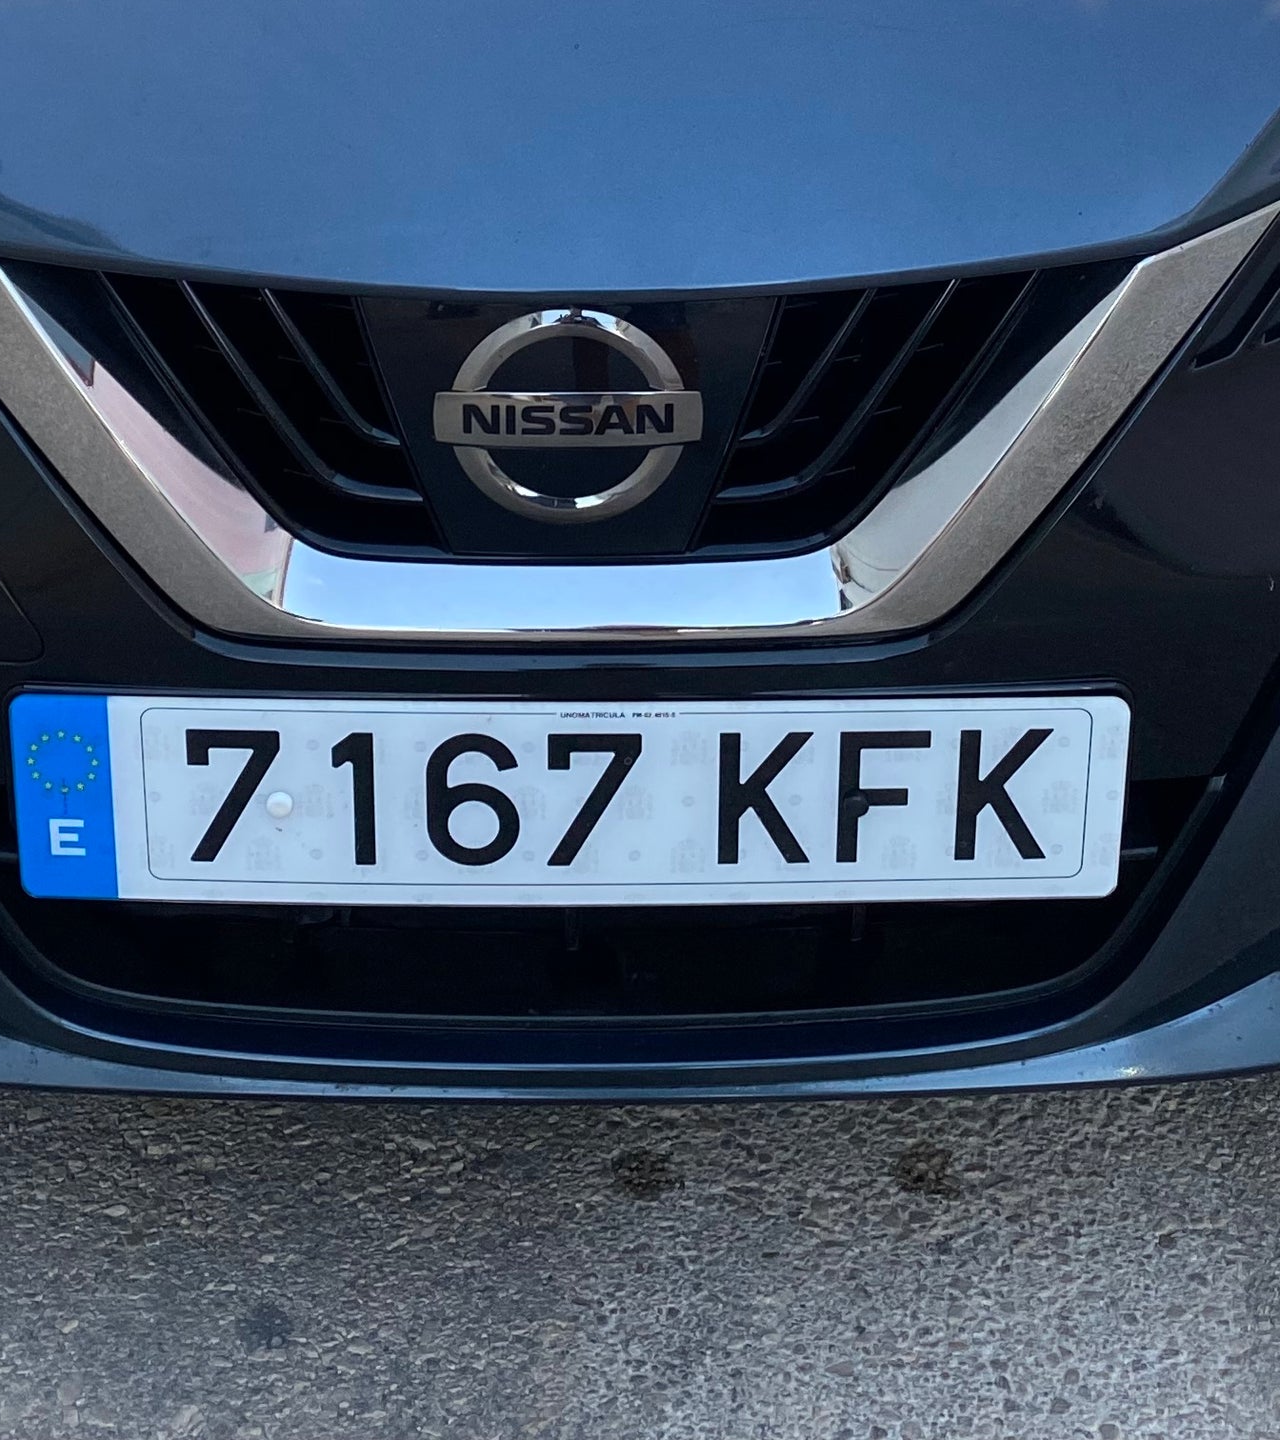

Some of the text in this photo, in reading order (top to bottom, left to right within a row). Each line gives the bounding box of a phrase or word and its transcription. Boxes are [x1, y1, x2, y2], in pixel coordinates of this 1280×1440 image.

[462, 403, 674, 435] NISSAN
[186, 729, 1054, 866] 7167 KFK
[49, 818, 86, 856] E
